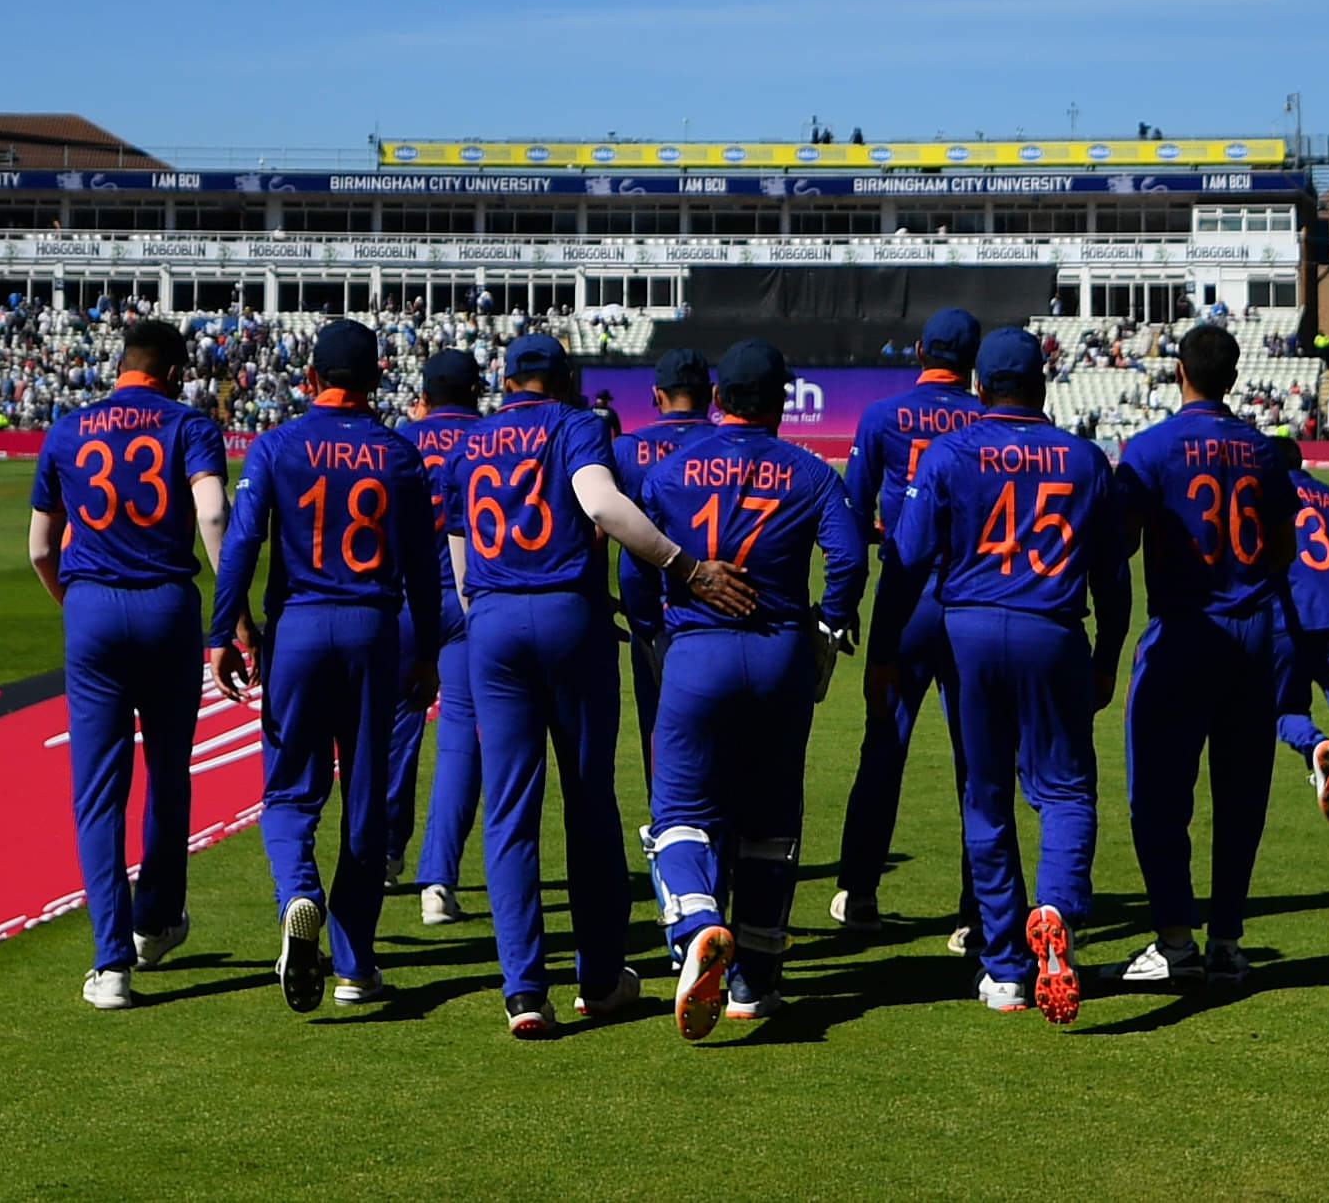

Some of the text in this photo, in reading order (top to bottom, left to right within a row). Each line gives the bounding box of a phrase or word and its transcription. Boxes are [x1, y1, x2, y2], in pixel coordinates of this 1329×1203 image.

[158, 173, 175, 188] AM
[178, 173, 200, 188] BCU
[330, 176, 551, 191] BIRMINGHAM CITY UNIVERSITY
[684, 177, 702, 192] AM
[705, 177, 726, 192] BCU
[853, 176, 1072, 192] BIRMINGHAM CITY UNIVERSITY
[1209, 174, 1226, 190] AM
[1229, 174, 1251, 190] BCU
[36, 241, 100, 256] HOBGOBLIN
[142, 242, 206, 257] HOBGOBLIN
[248, 243, 312, 258] HOBGOBLIN
[354, 244, 417, 259] HOBGOBLIN
[458, 244, 521, 260] HOBGOBLIN
[563, 244, 624, 260] HOBGOBLIN
[666, 244, 728, 260] HOBGOBLIN
[770, 244, 831, 260] HOBGOBLIN
[873, 244, 935, 260] HOBGOBLIN
[976, 244, 1038, 260] HOBGOBLIN
[1080, 244, 1143, 260] HOBGOBLIN
[1186, 244, 1249, 260] HOBGOBLIN
[79, 407, 162, 437] HARDIK
[898, 407, 915, 433] D
[465, 426, 549, 461] SURYA
[305, 440, 388, 472] VIRAT
[638, 440, 650, 466] B
[979, 444, 1069, 475] ROHIT
[1184, 438, 1262, 470] H PATEL
[684, 458, 792, 490] RISHABH
[75, 435, 169, 530] 33
[467, 458, 553, 560] 63
[298, 475, 389, 573] 18
[1186, 473, 1264, 565] 36
[690, 493, 780, 569] 17
[977, 480, 1074, 577] 45
